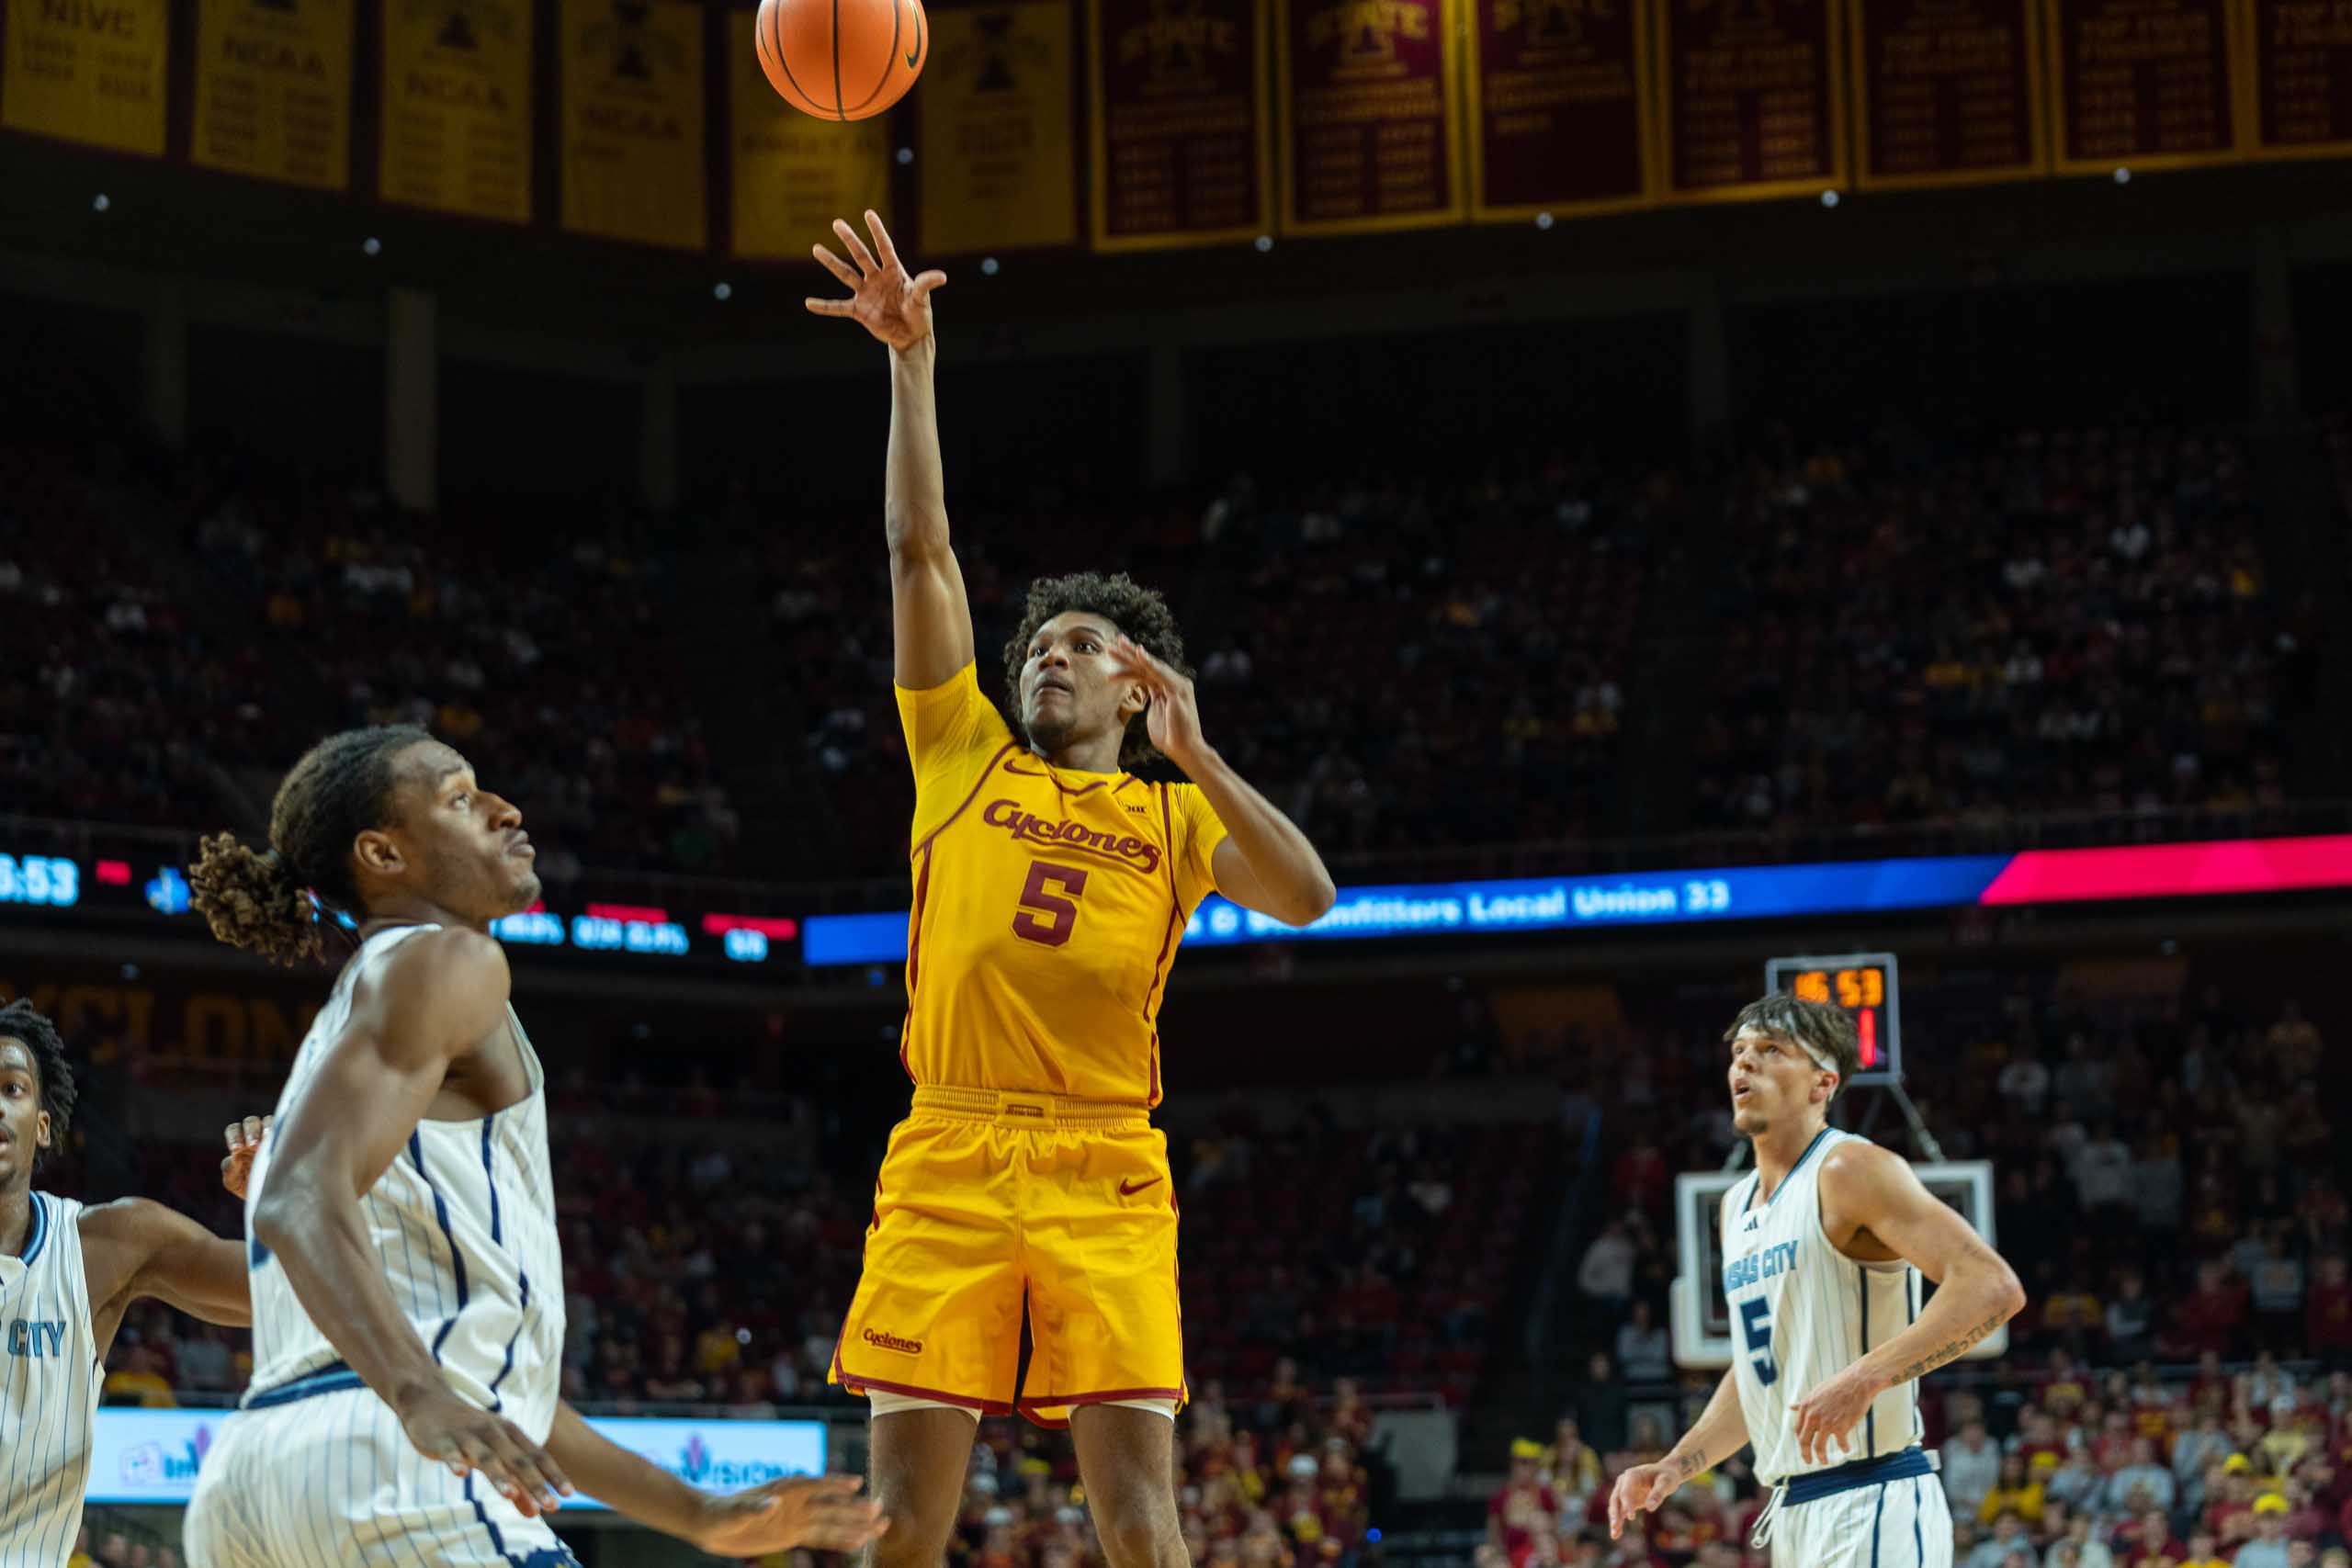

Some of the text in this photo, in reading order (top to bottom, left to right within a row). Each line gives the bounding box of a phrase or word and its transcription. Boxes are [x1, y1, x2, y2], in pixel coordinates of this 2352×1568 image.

[221, 35, 327, 79] NCAA
[982, 798, 1161, 874] Cyclones
[1011, 859, 1089, 949] 5
[1467, 886, 1564, 924] Local
[1573, 883, 1679, 919] Union
[1686, 876, 1732, 915] 33
[1762, 1239, 1797, 1279] CITY
[7, 1319, 67, 1358] CITY
[863, 1328, 923, 1354] Cyclones
[1738, 1294, 1779, 1387] 5
